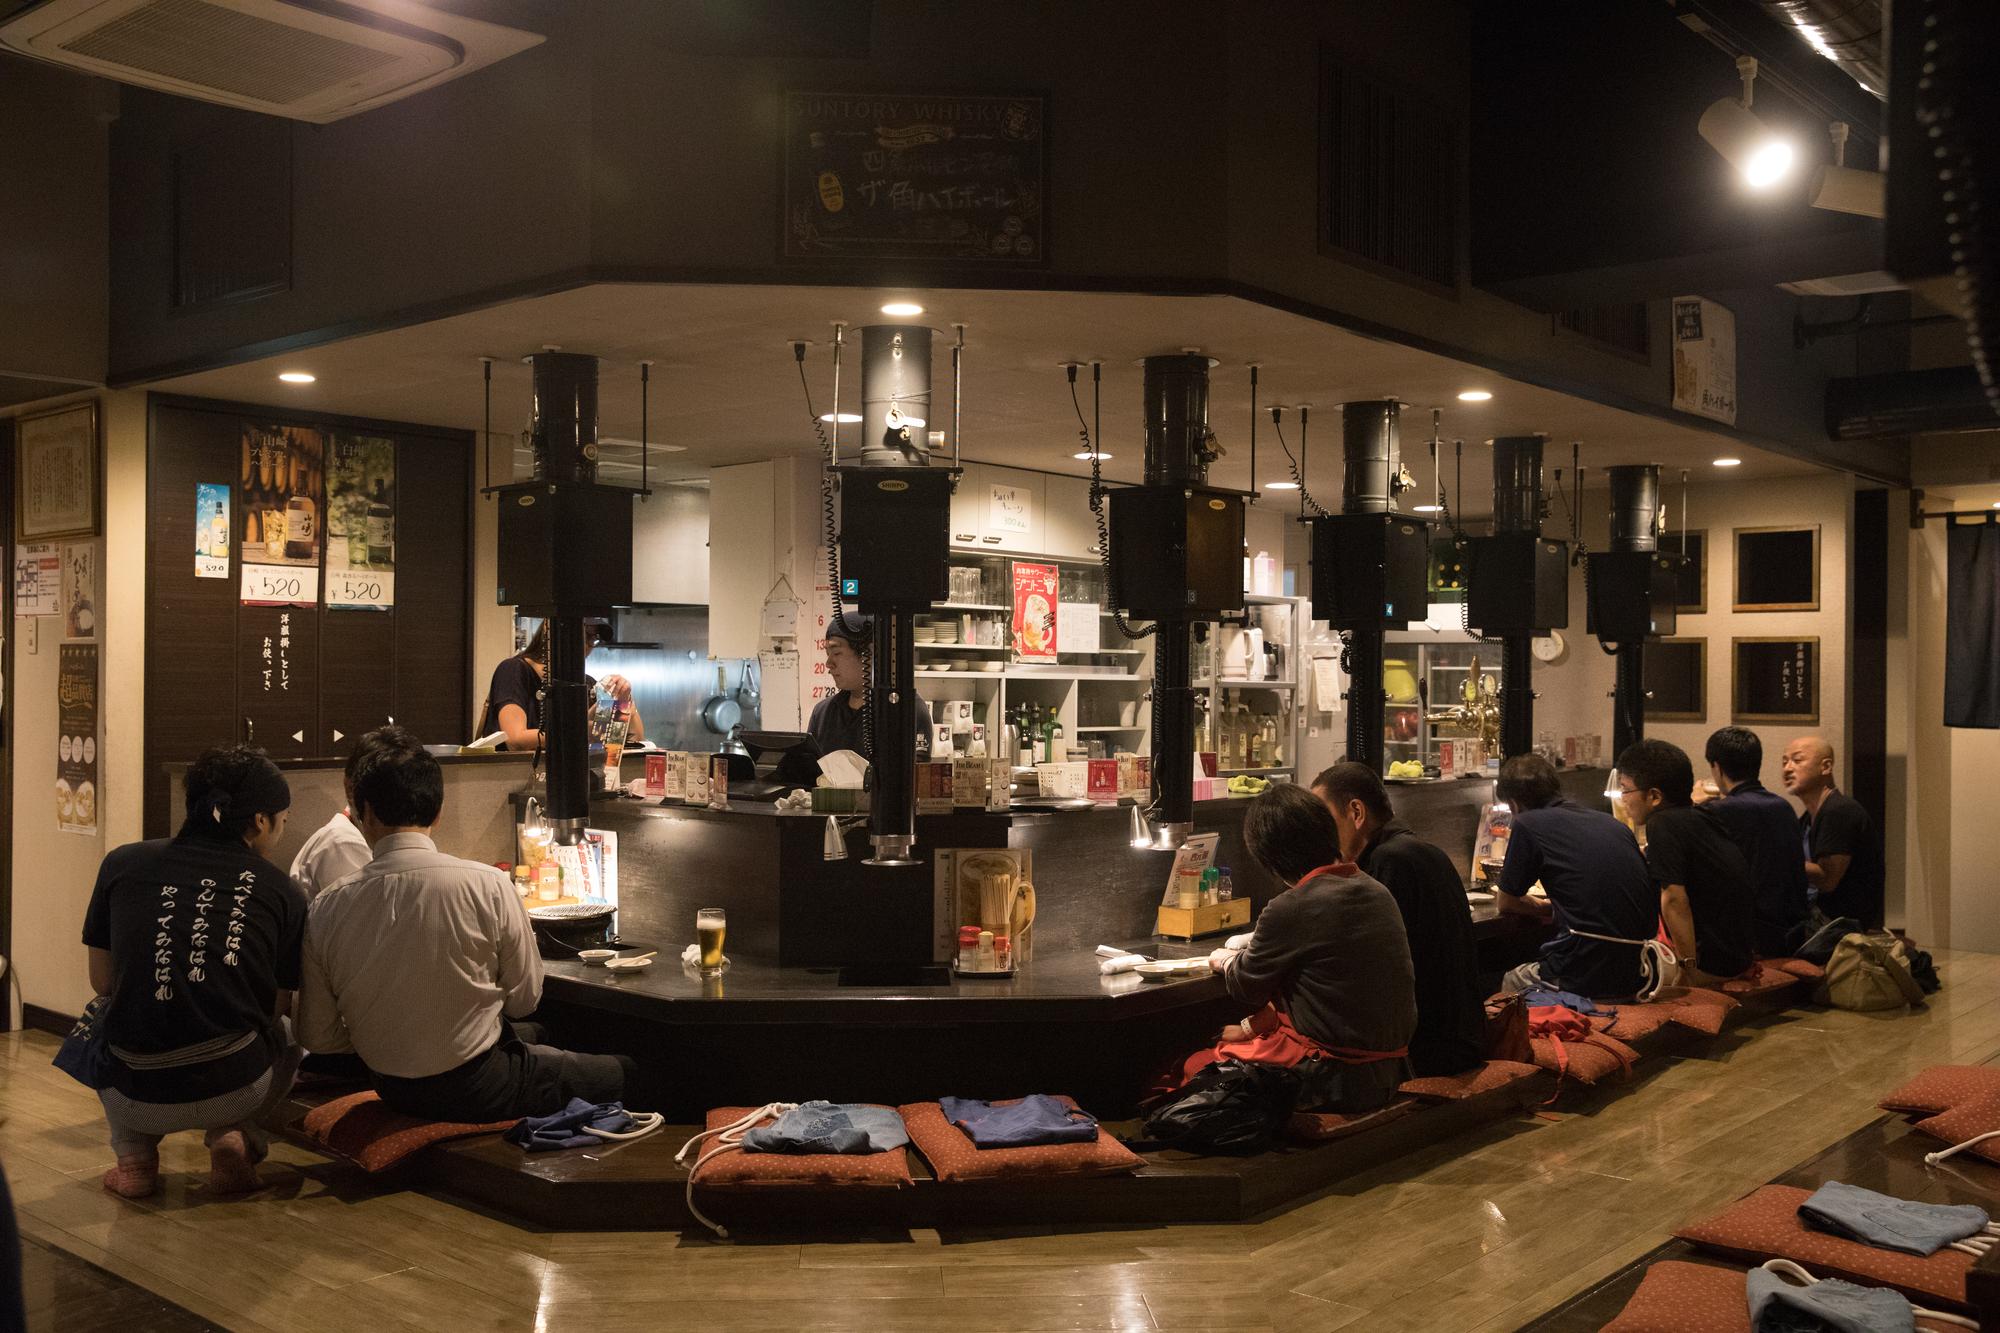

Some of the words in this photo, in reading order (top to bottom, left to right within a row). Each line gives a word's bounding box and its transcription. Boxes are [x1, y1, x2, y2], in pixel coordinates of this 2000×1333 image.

[913, 103, 1006, 122] WHISKY
[263, 576, 301, 597] 520
[344, 581, 382, 600] 520
[846, 582, 856, 592] 2
[817, 615, 825, 627] 6
[814, 662, 825, 674] 20
[812, 686, 824, 698] 27
[825, 686, 836, 698] 28
[223, 869, 257, 967] たべてみなはれ
[154, 885, 179, 1001] やってみなはれ
